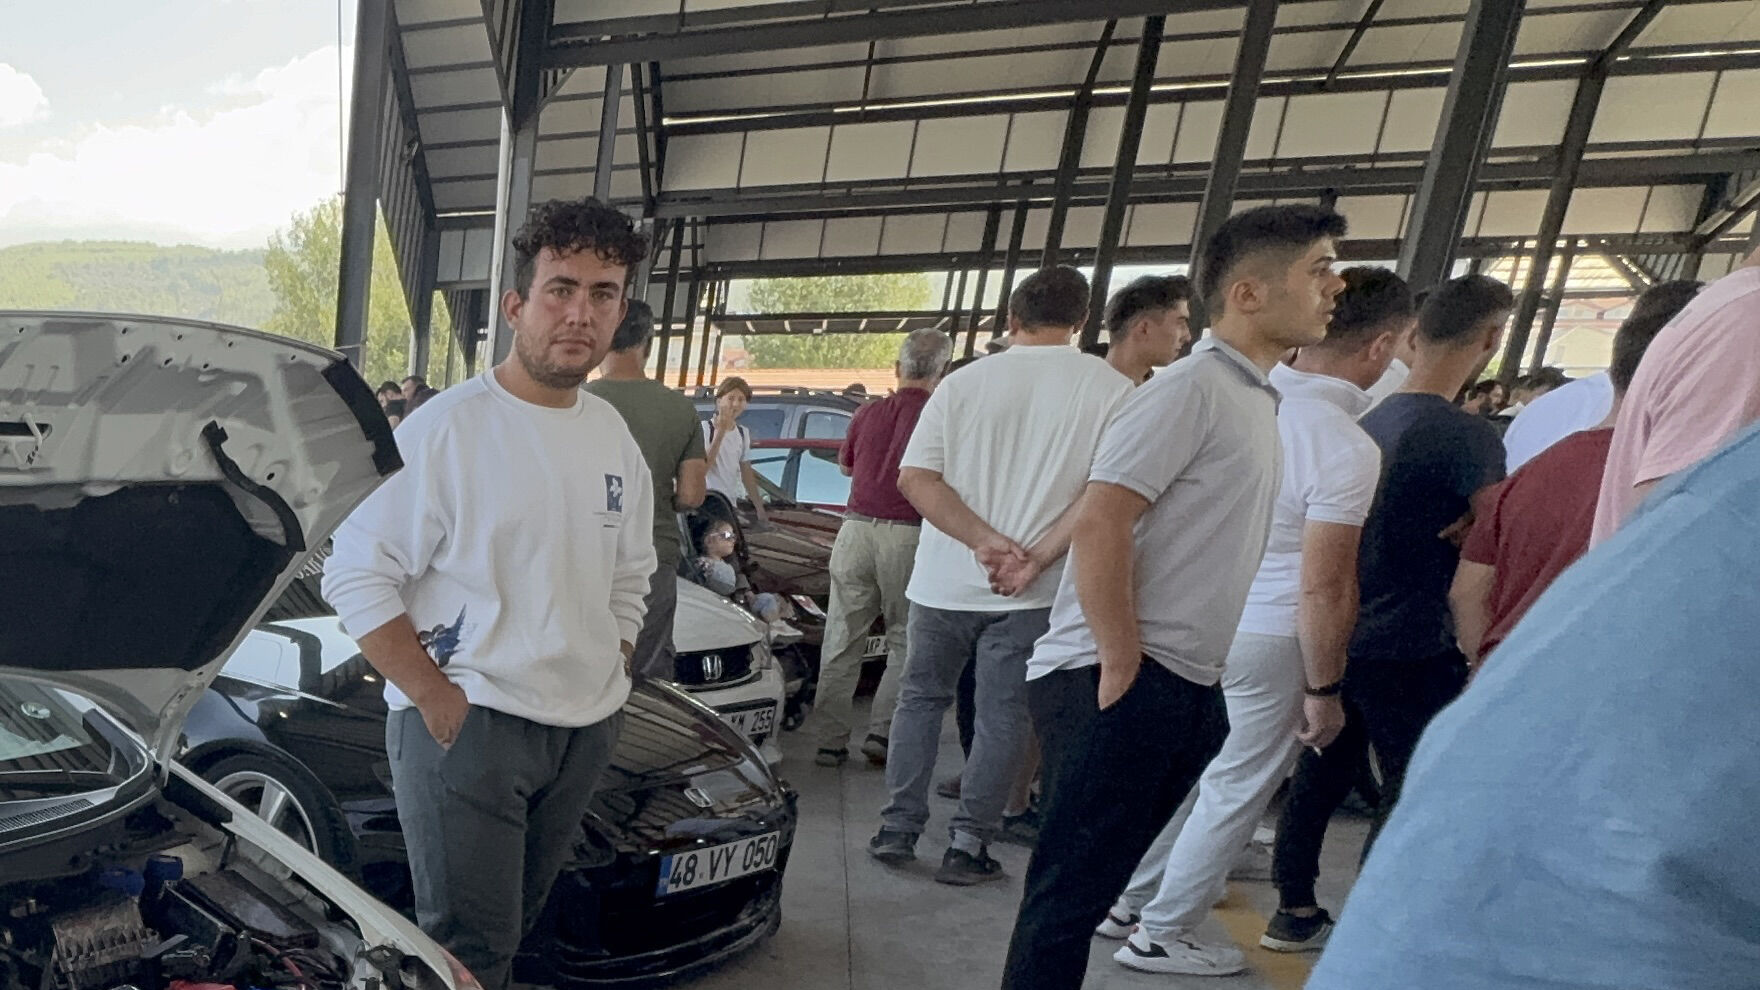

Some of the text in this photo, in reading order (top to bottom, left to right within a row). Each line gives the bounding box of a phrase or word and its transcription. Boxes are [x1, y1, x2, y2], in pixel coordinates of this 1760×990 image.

[750, 709, 773, 732] 255
[670, 834, 778, 888] 48 VY 050
